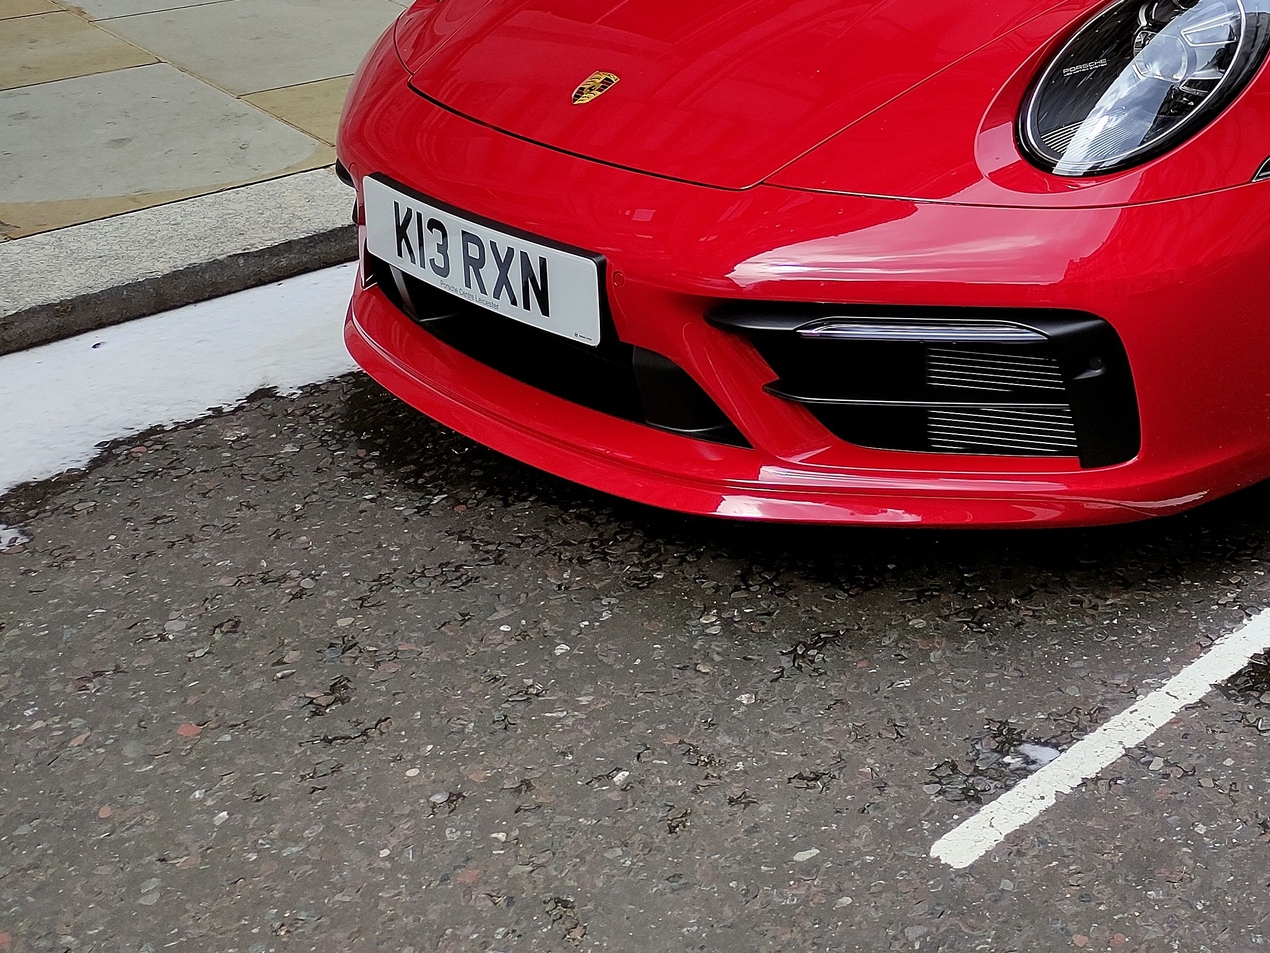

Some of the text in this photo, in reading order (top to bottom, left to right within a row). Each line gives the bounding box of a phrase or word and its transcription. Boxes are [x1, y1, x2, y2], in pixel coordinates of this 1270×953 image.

[1062, 58, 1107, 74] PORSCHE
[393, 200, 550, 318] K13 RXN
[440, 279, 499, 309] Porsche Centre Leicester
